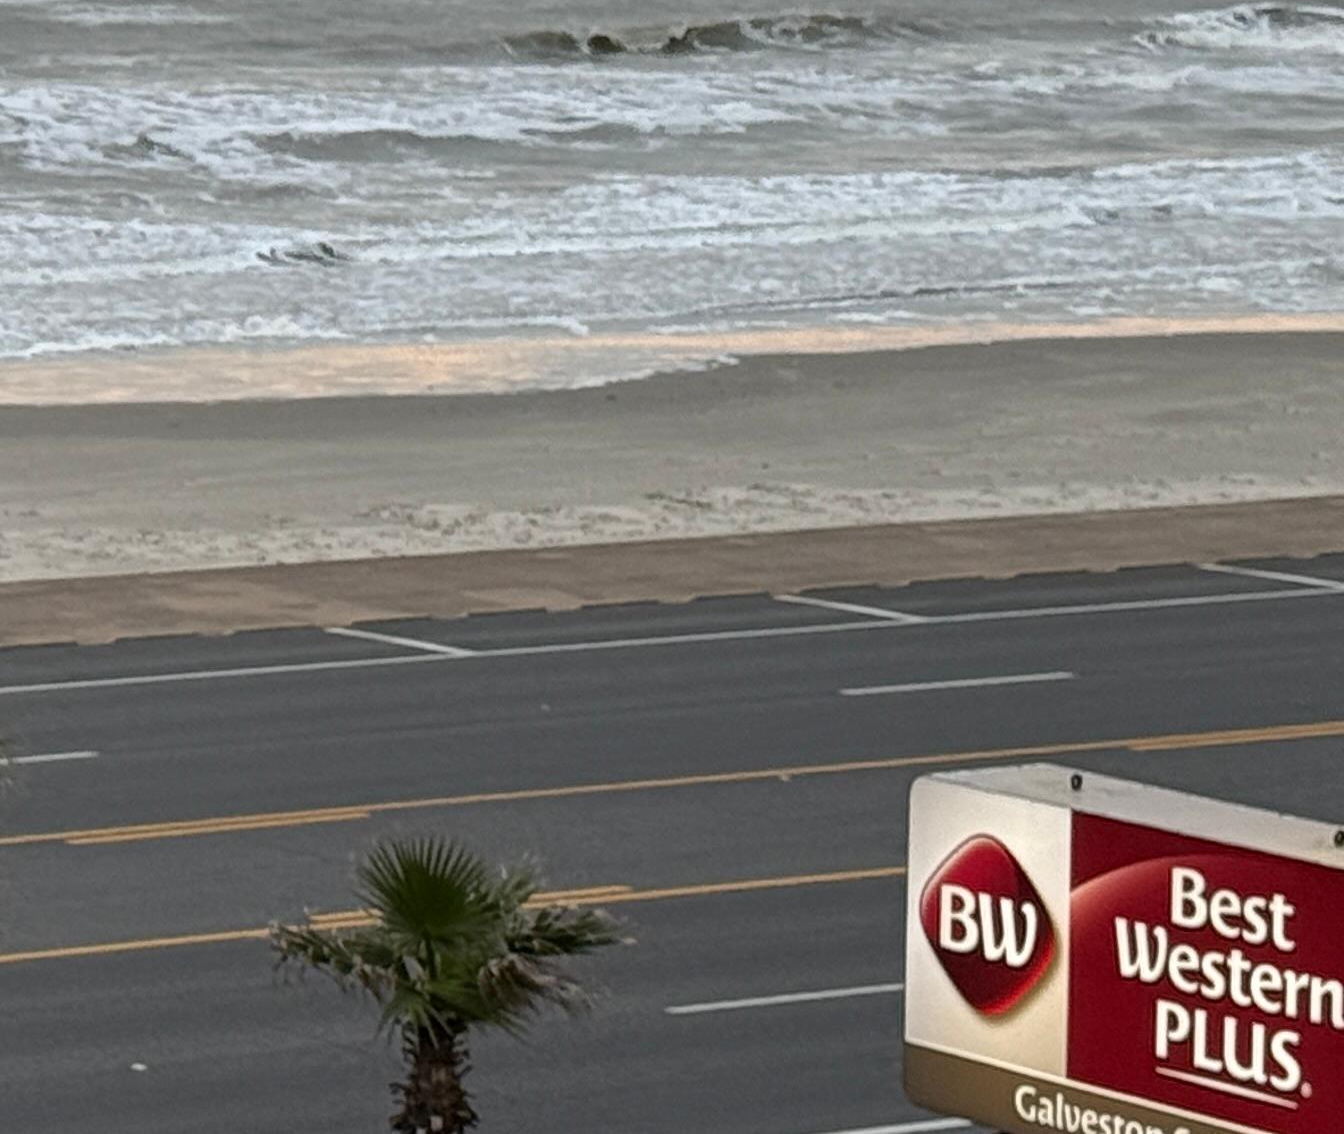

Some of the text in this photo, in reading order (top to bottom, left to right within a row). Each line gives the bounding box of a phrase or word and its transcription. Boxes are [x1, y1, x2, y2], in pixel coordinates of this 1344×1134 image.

[939, 883, 1037, 966] BW
[1170, 867, 1295, 951] Best
[1115, 917, 1344, 1029] Western
